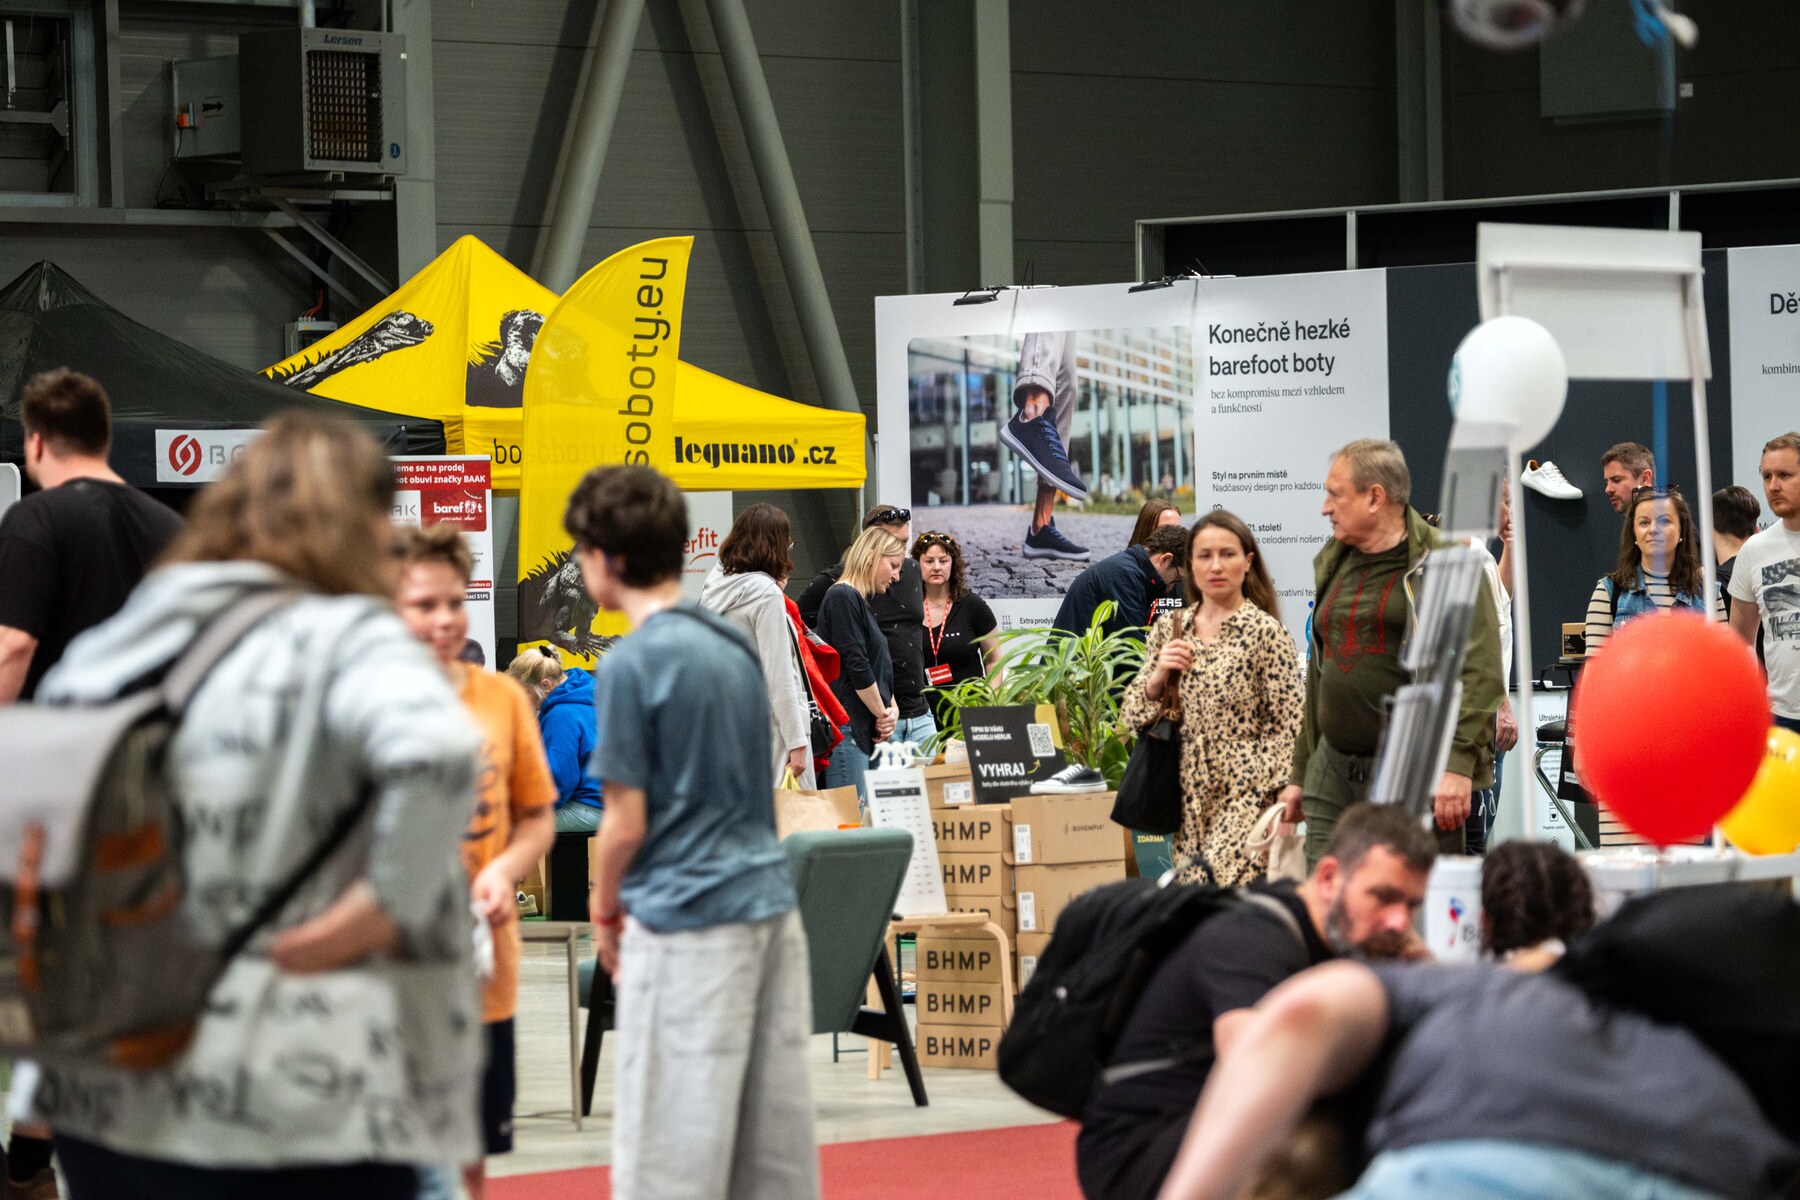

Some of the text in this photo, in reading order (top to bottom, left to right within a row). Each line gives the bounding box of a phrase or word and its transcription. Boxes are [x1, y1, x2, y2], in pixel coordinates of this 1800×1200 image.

[324, 34, 362, 45] Lersen
[1770, 292, 1800, 314] Dě
[1209, 318, 1350, 344] Konečně hezké
[618, 257, 671, 468] soboty.eu
[1209, 352, 1335, 376] barefoot boty
[1211, 385, 1345, 400] bez kompromisu mezi vzhledem
[1211, 402, 1262, 414] a funkčností
[438, 463, 465, 473] prodej
[409, 475, 433, 484] obuvi
[433, 475, 462, 485] značky
[463, 475, 486, 483] BAAK
[1212, 471, 1227, 481] Styl
[1239, 471, 1266, 480] prvním
[1266, 470, 1288, 479] místě
[1212, 483, 1252, 493] Nadčasový
[1253, 483, 1279, 493] design
[1294, 482, 1321, 490] každou
[1258, 523, 1282, 532] století
[682, 528, 718, 555] erfit
[1261, 536, 1298, 544] celodenní
[1299, 535, 1324, 543] nošení
[1151, 598, 1182, 607] ERS
[1020, 617, 1034, 625] Extra
[978, 763, 1025, 777] VYHRAJ
[943, 864, 991, 884] HMP
[927, 950, 991, 971] BHMP
[927, 993, 991, 1014] BHMP
[927, 1036, 991, 1057] BHMP
